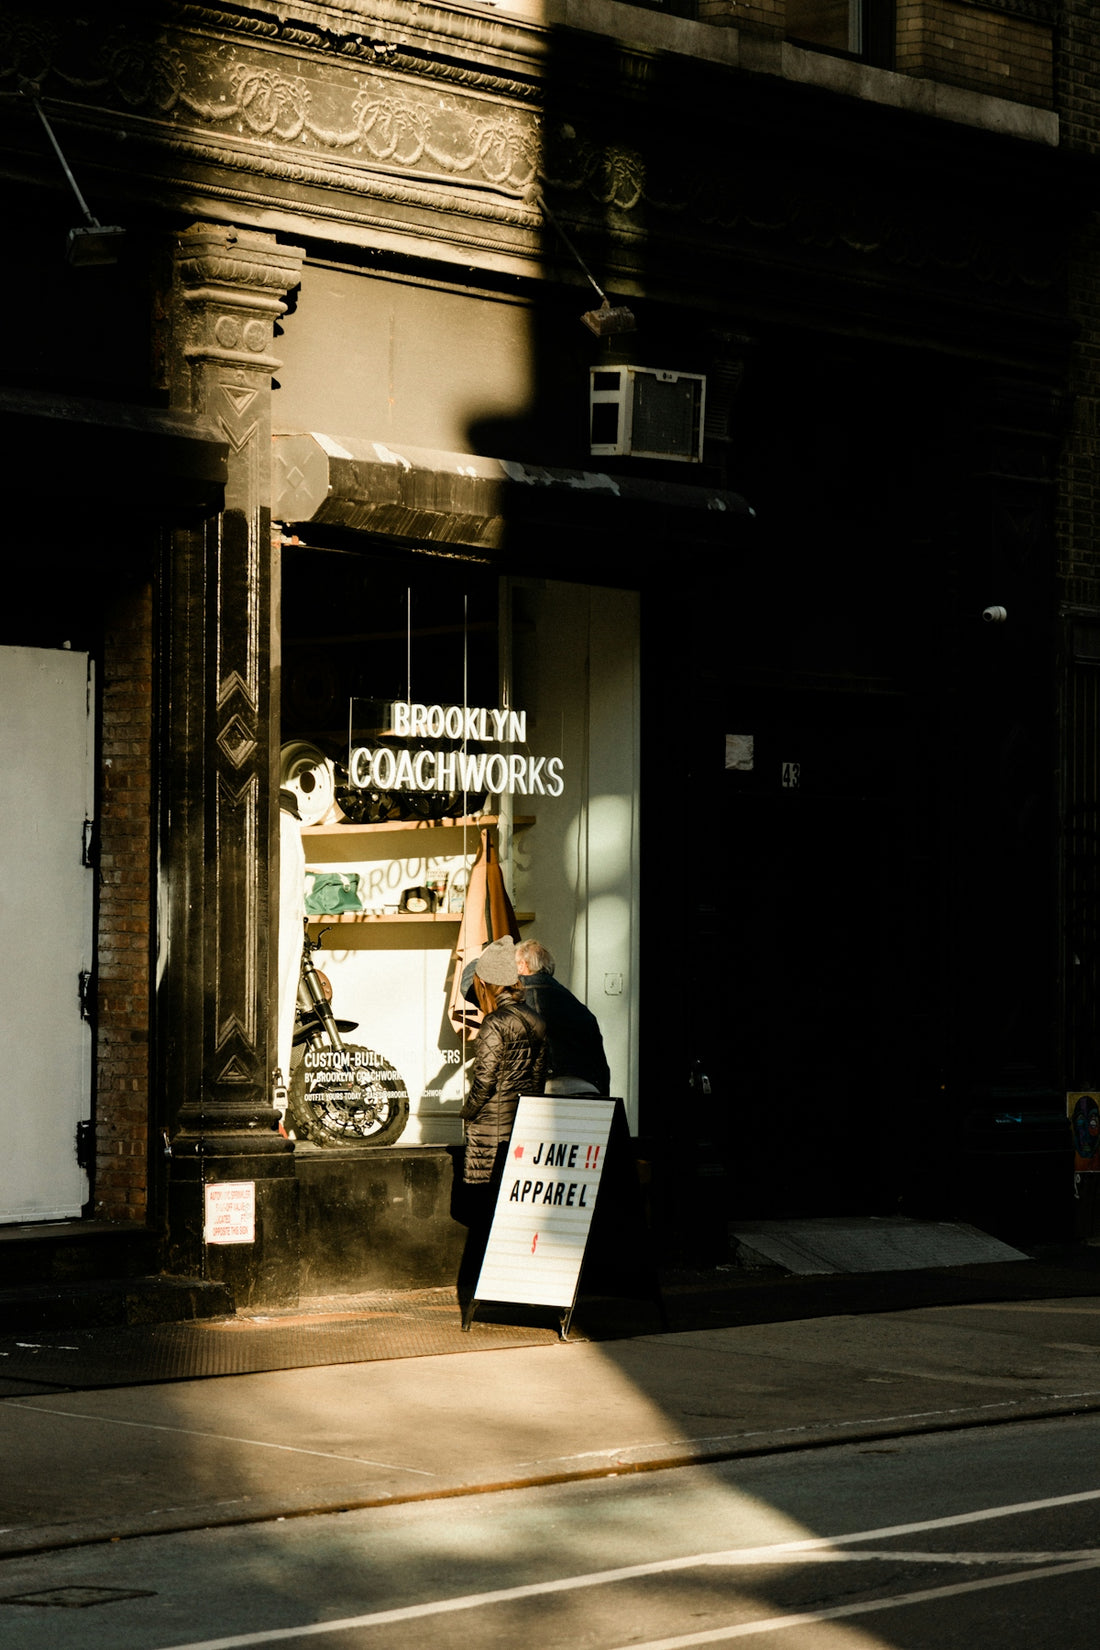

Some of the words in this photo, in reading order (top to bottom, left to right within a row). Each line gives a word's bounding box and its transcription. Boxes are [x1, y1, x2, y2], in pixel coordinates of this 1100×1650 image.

[393, 702, 527, 742] BROOKLYN
[349, 746, 565, 797] COACHWORKS
[783, 763, 800, 788] 43
[304, 1072, 315, 1083] BY
[356, 1070, 406, 1081] COACHWORK
[533, 1142, 579, 1168] JANE
[509, 1179, 587, 1207] APPAREL
